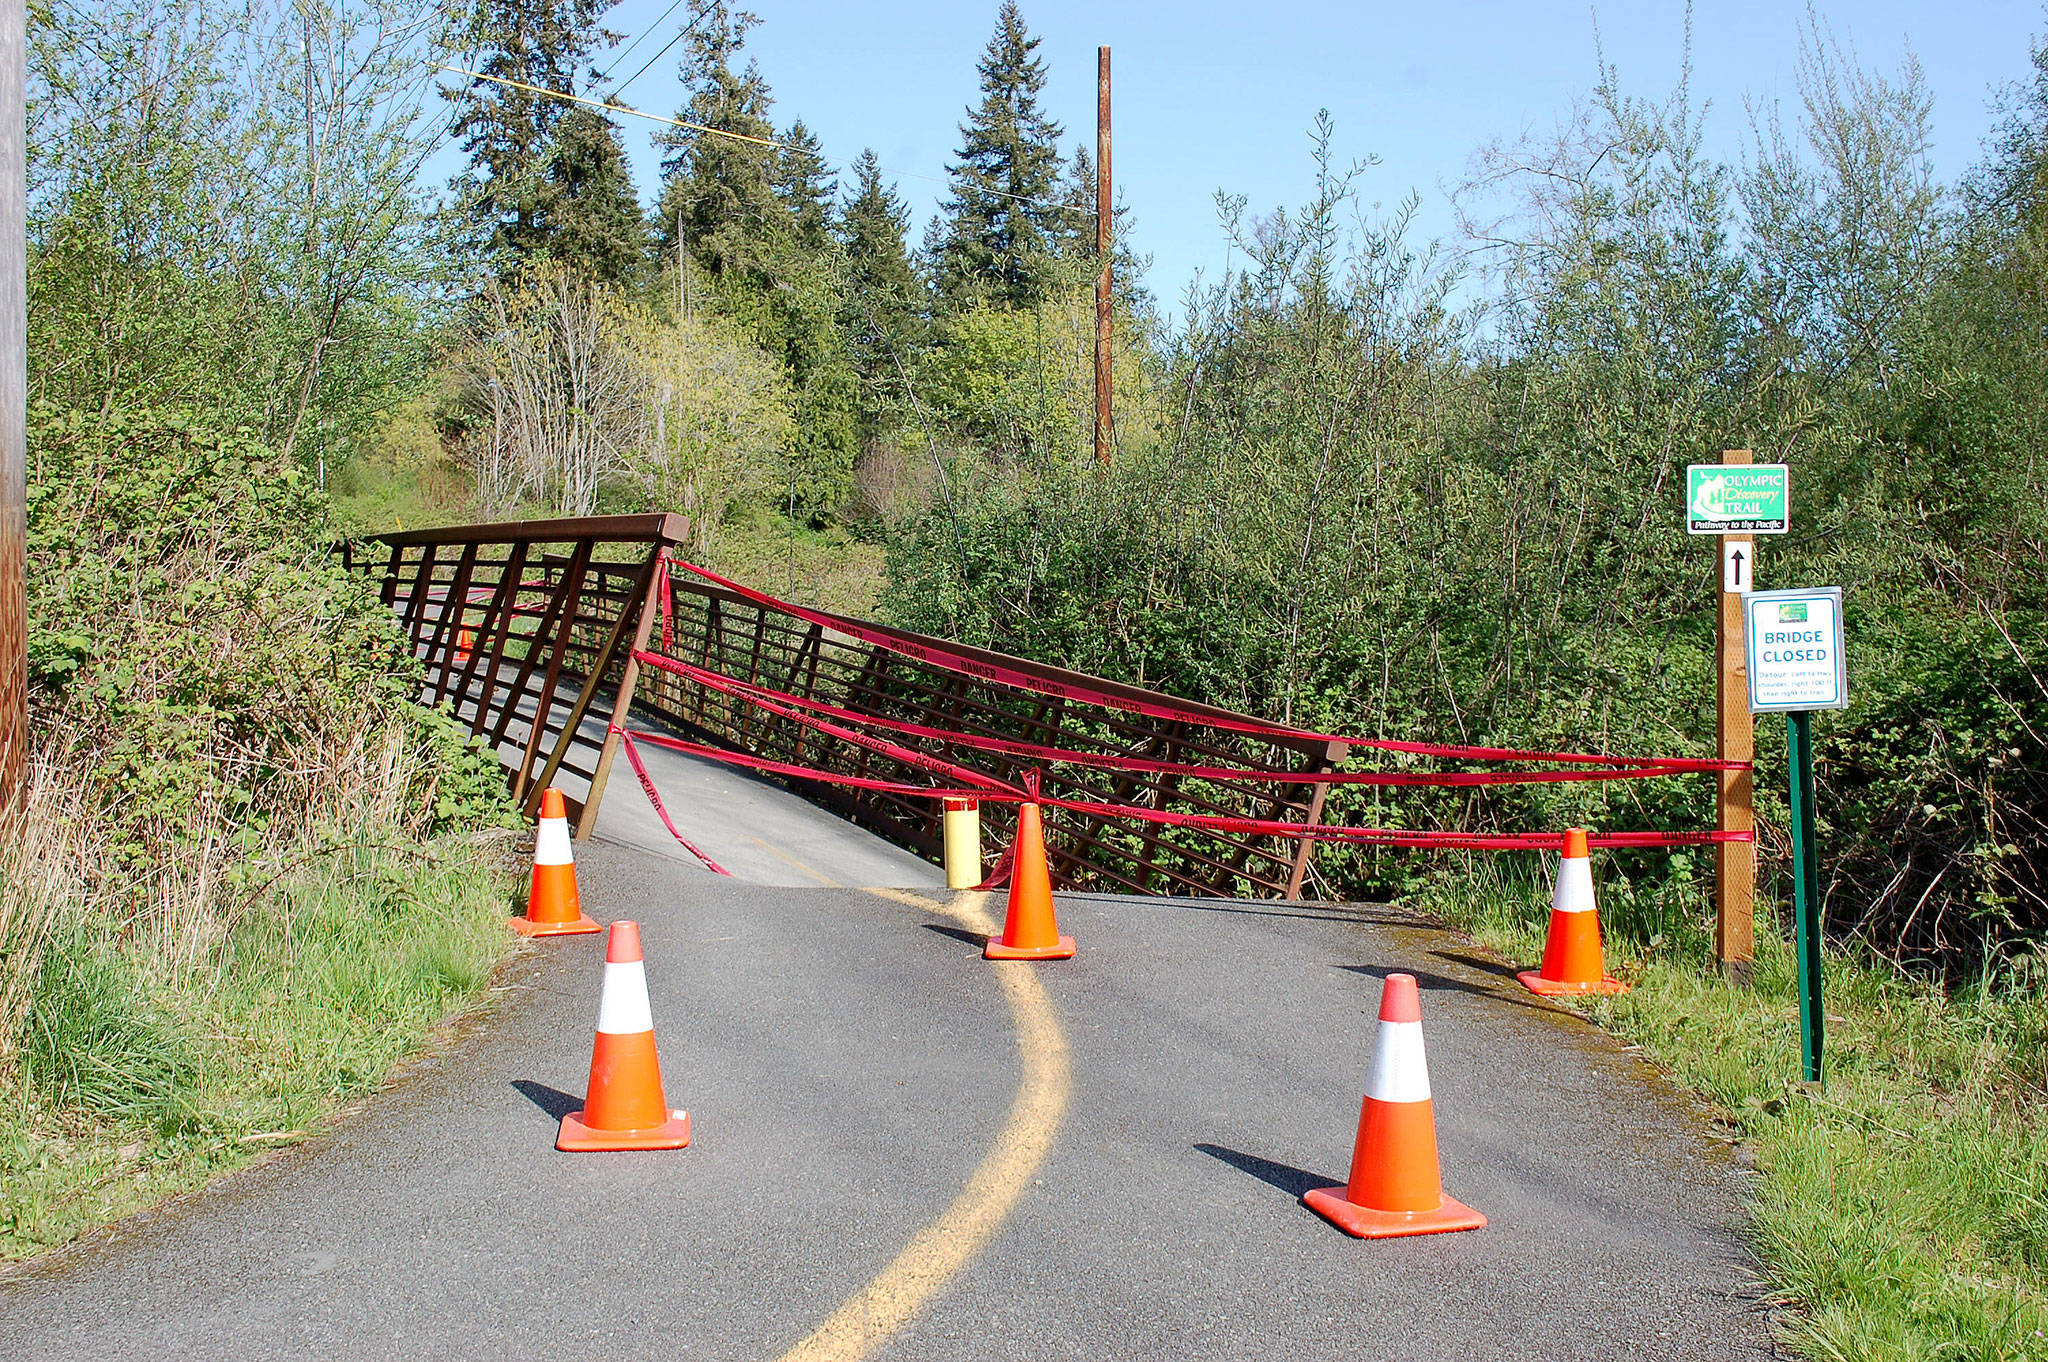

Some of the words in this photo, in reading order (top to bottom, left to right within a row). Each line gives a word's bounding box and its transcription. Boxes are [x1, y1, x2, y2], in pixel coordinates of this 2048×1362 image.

[1725, 475, 1782, 487] OLYMPIC
[1725, 488, 1779, 504] Discovery
[1725, 502, 1763, 513] TRAIL
[1695, 520, 1729, 530] Pathway
[1730, 520, 1740, 529] to
[1741, 520, 1754, 529] the
[1755, 520, 1782, 529] Pacific
[1765, 630, 1824, 644] BRIDGE
[830, 621, 863, 639] DANGER
[889, 640, 926, 660] PELIGRO
[960, 661, 996, 680] DANGER
[1025, 678, 1065, 696] PELIGRO
[1763, 649, 1827, 663] CLOSED
